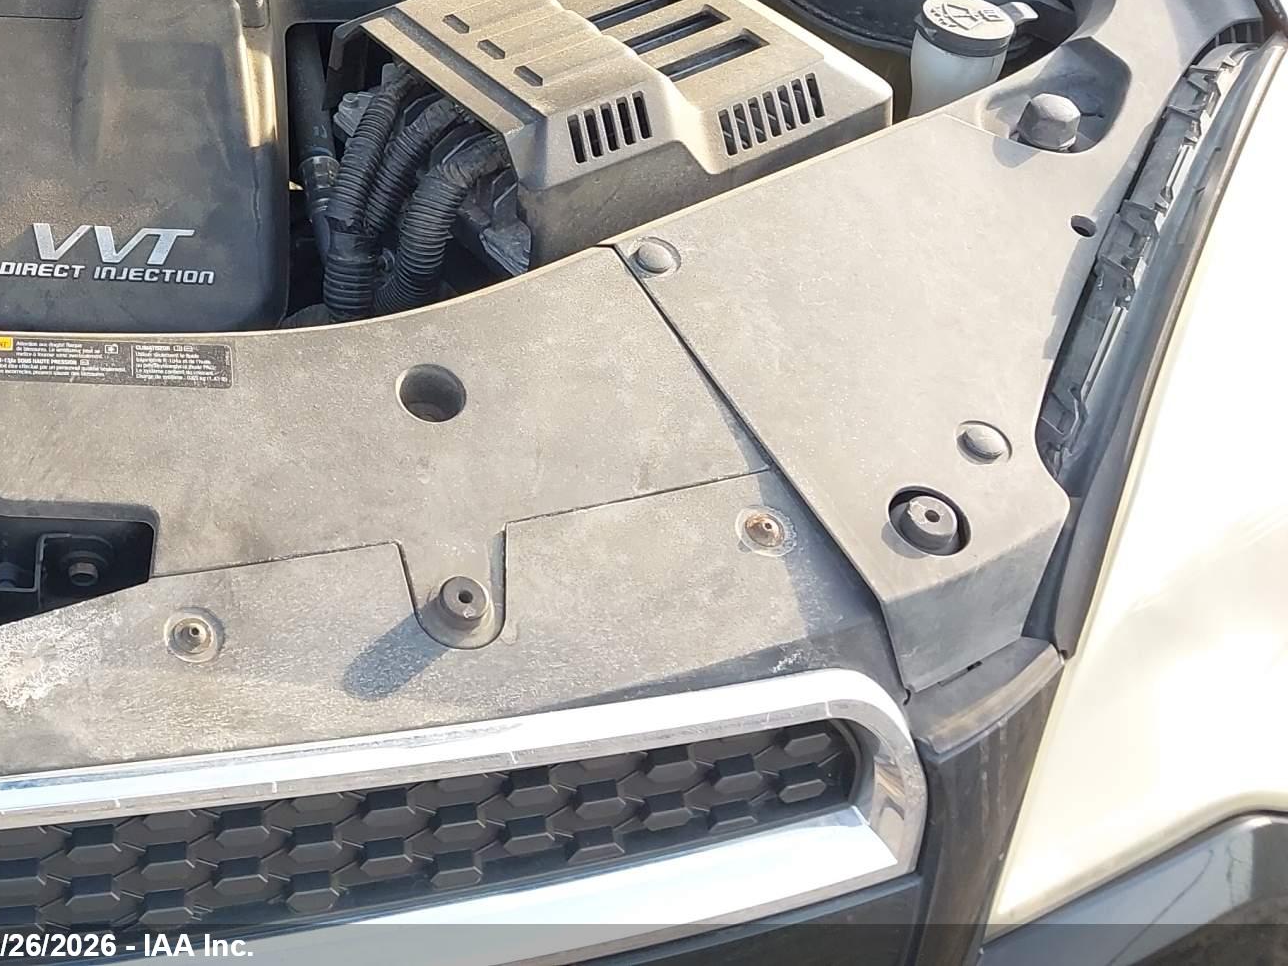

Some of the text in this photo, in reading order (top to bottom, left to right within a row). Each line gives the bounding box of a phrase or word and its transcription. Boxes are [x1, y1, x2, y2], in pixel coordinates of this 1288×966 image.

[32, 222, 195, 265] VVT
[0, 261, 215, 285] DIRECT INJECTION
